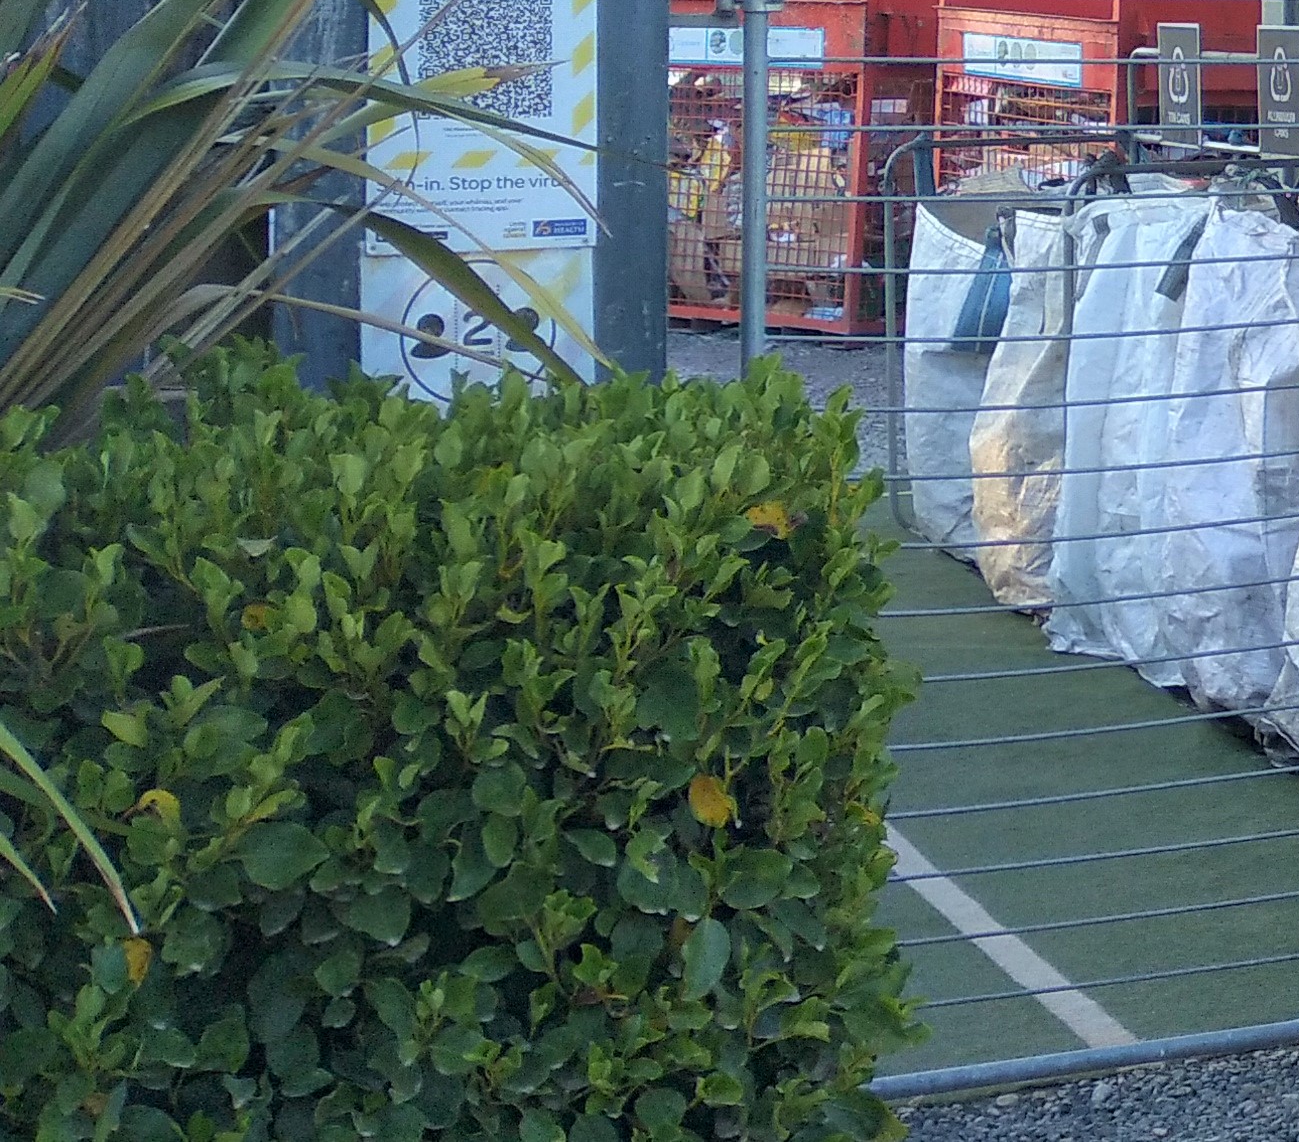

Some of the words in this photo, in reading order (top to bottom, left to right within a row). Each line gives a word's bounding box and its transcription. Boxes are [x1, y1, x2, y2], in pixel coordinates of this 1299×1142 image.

[449, 176, 492, 193] Stop
[495, 176, 525, 190] the
[528, 174, 561, 188] viru
[554, 226, 585, 234] HEALTH
[463, 310, 494, 346] 2
